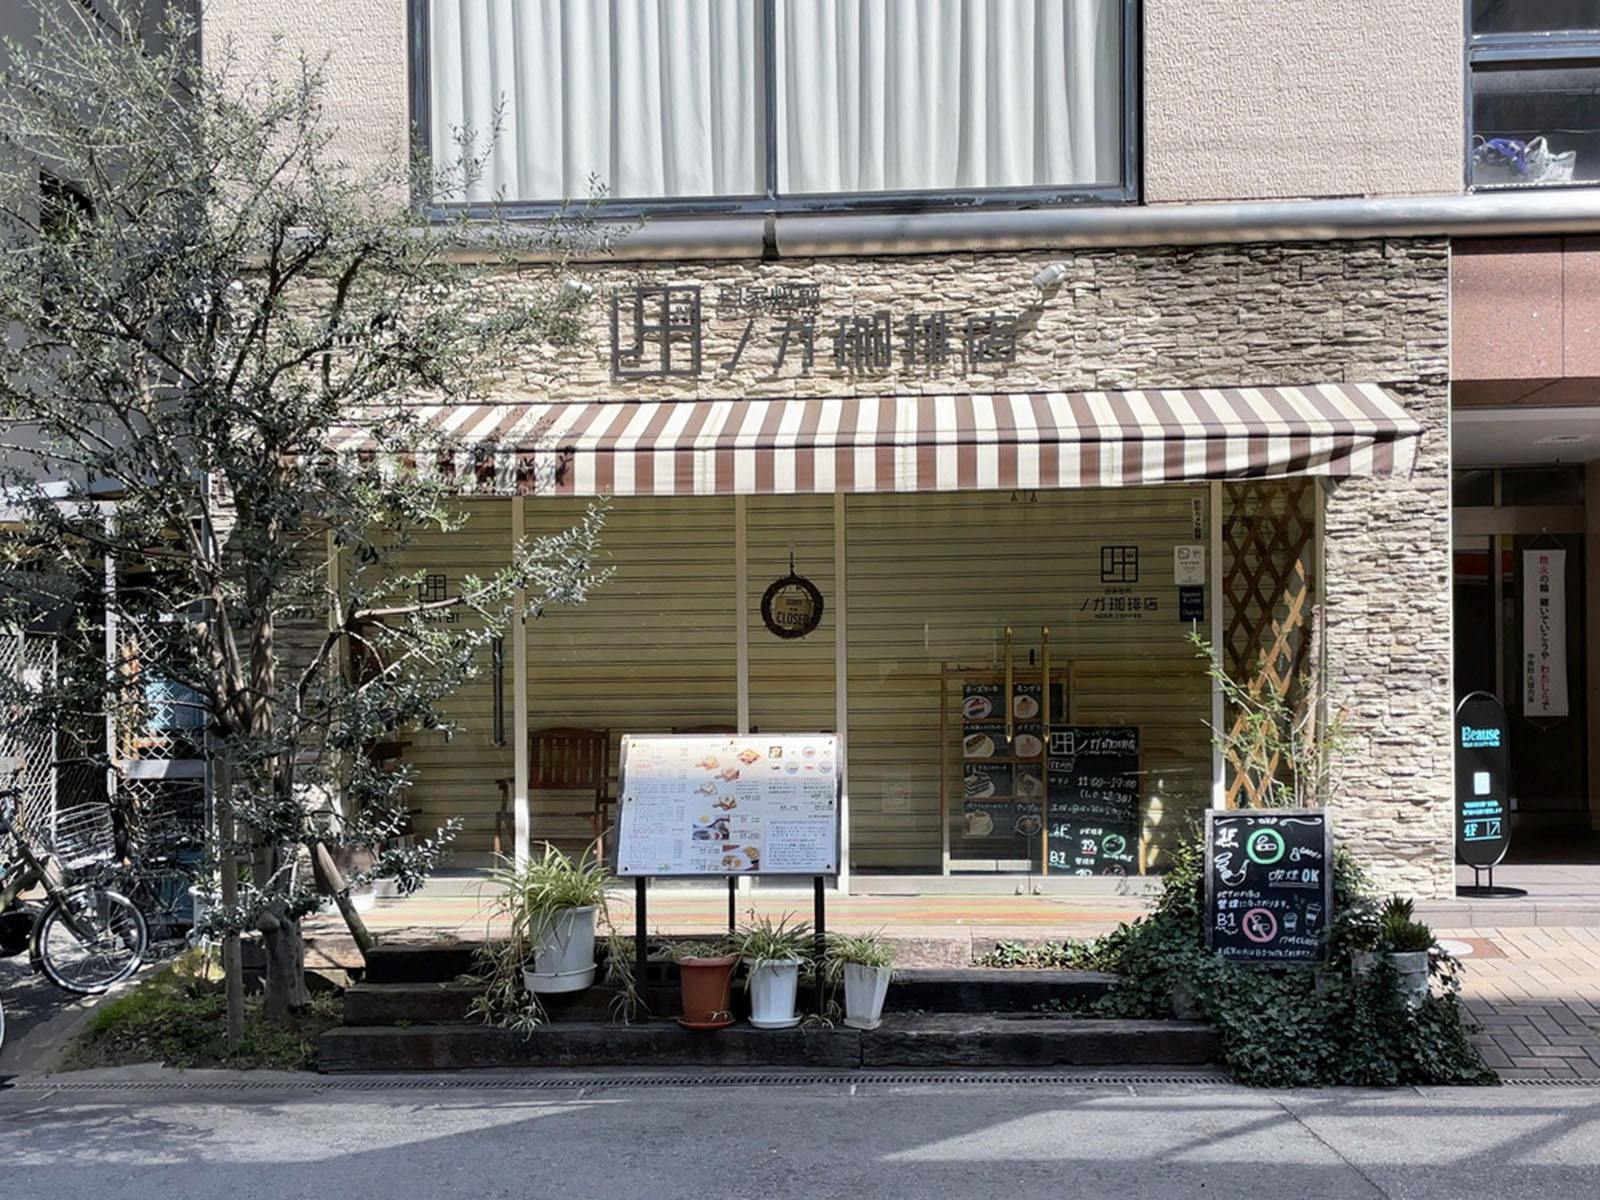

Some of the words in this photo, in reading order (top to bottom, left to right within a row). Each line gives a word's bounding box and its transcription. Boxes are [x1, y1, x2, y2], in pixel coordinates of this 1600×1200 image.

[721, 310, 1017, 370] ノガ珈琲店
[1080, 597, 1158, 612] ノガ珈琲店
[776, 610, 810, 625] CLOSED
[1218, 827, 1238, 842] 1F
[1464, 823, 1478, 837] 4F
[1217, 912, 1237, 927] B1
